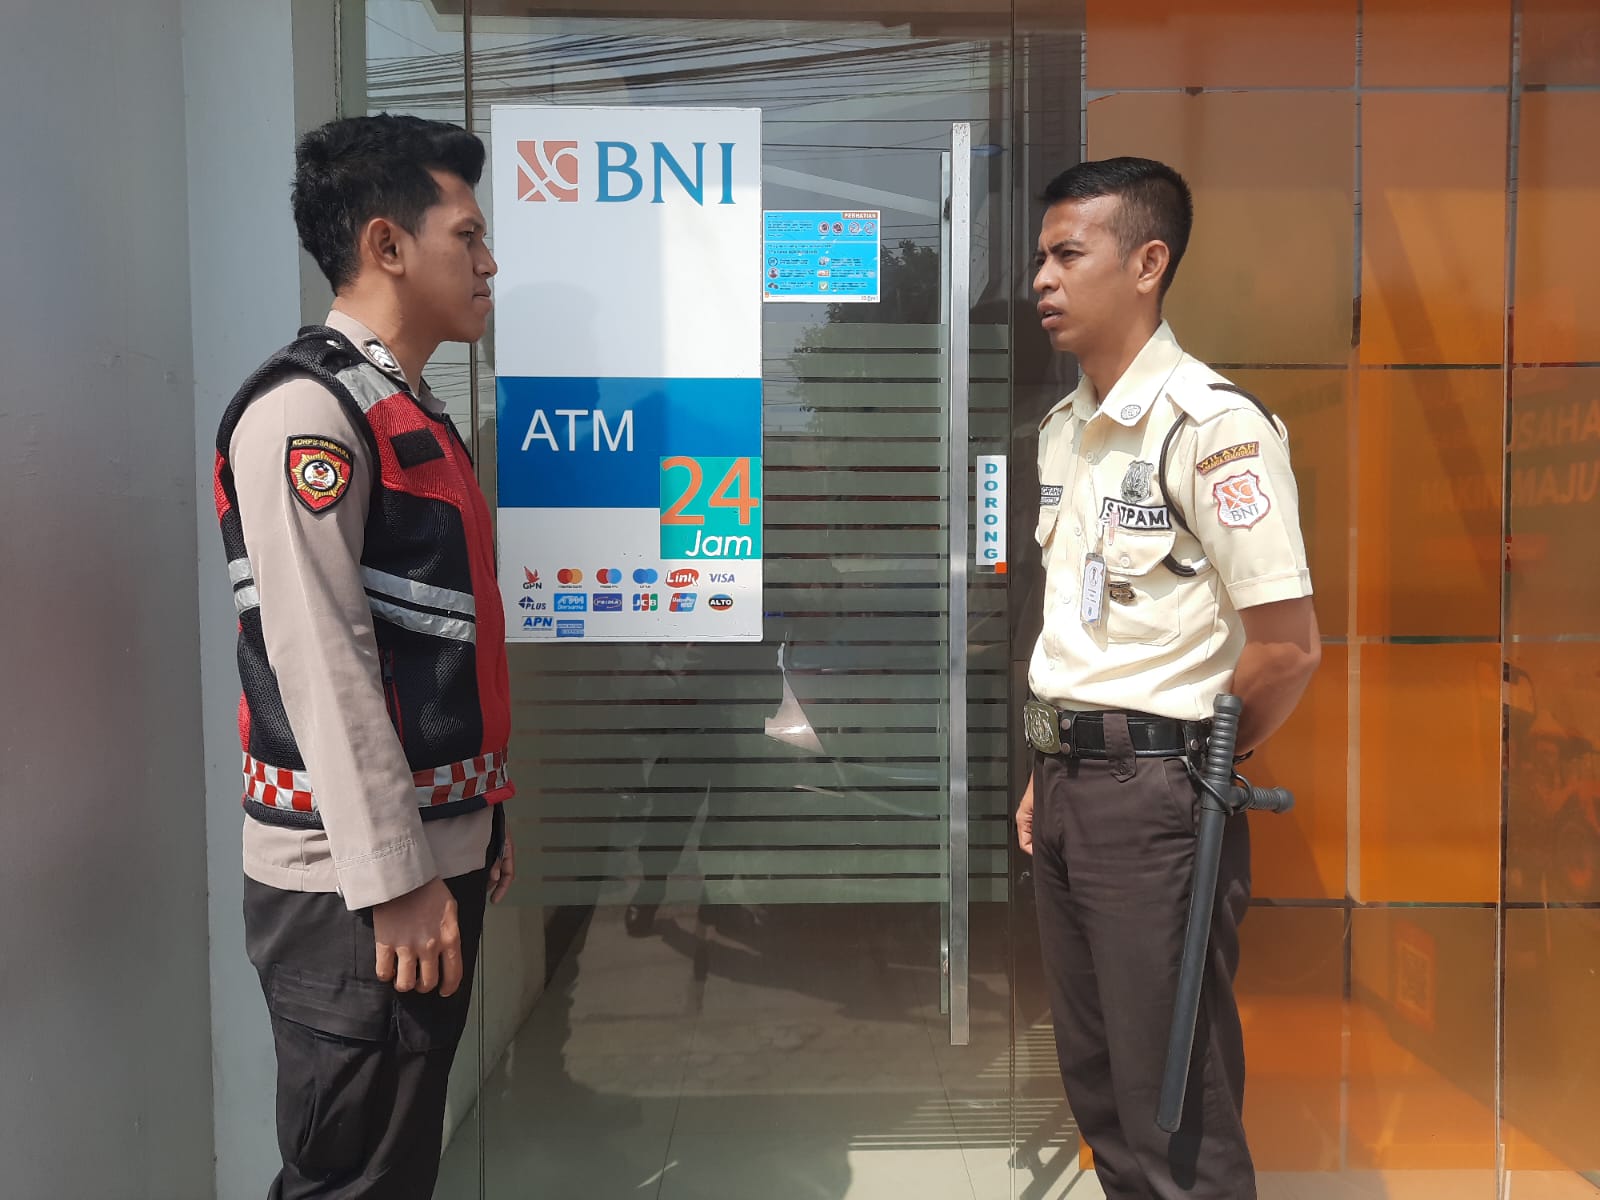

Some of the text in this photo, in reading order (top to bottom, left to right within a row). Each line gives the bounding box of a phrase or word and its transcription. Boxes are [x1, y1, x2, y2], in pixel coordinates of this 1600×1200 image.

[594, 141, 736, 206] BNI
[521, 409, 634, 451] ATM
[660, 456, 759, 525] 24
[983, 463, 998, 559] DORONG
[1106, 502, 1165, 526] STPAM
[1231, 503, 1259, 521] BNI
[685, 530, 752, 557] Jam
[522, 582, 542, 590] GPN
[666, 570, 698, 586] Link
[709, 573, 736, 583] VISA
[525, 602, 546, 610] PLUS
[523, 617, 553, 627] APN
